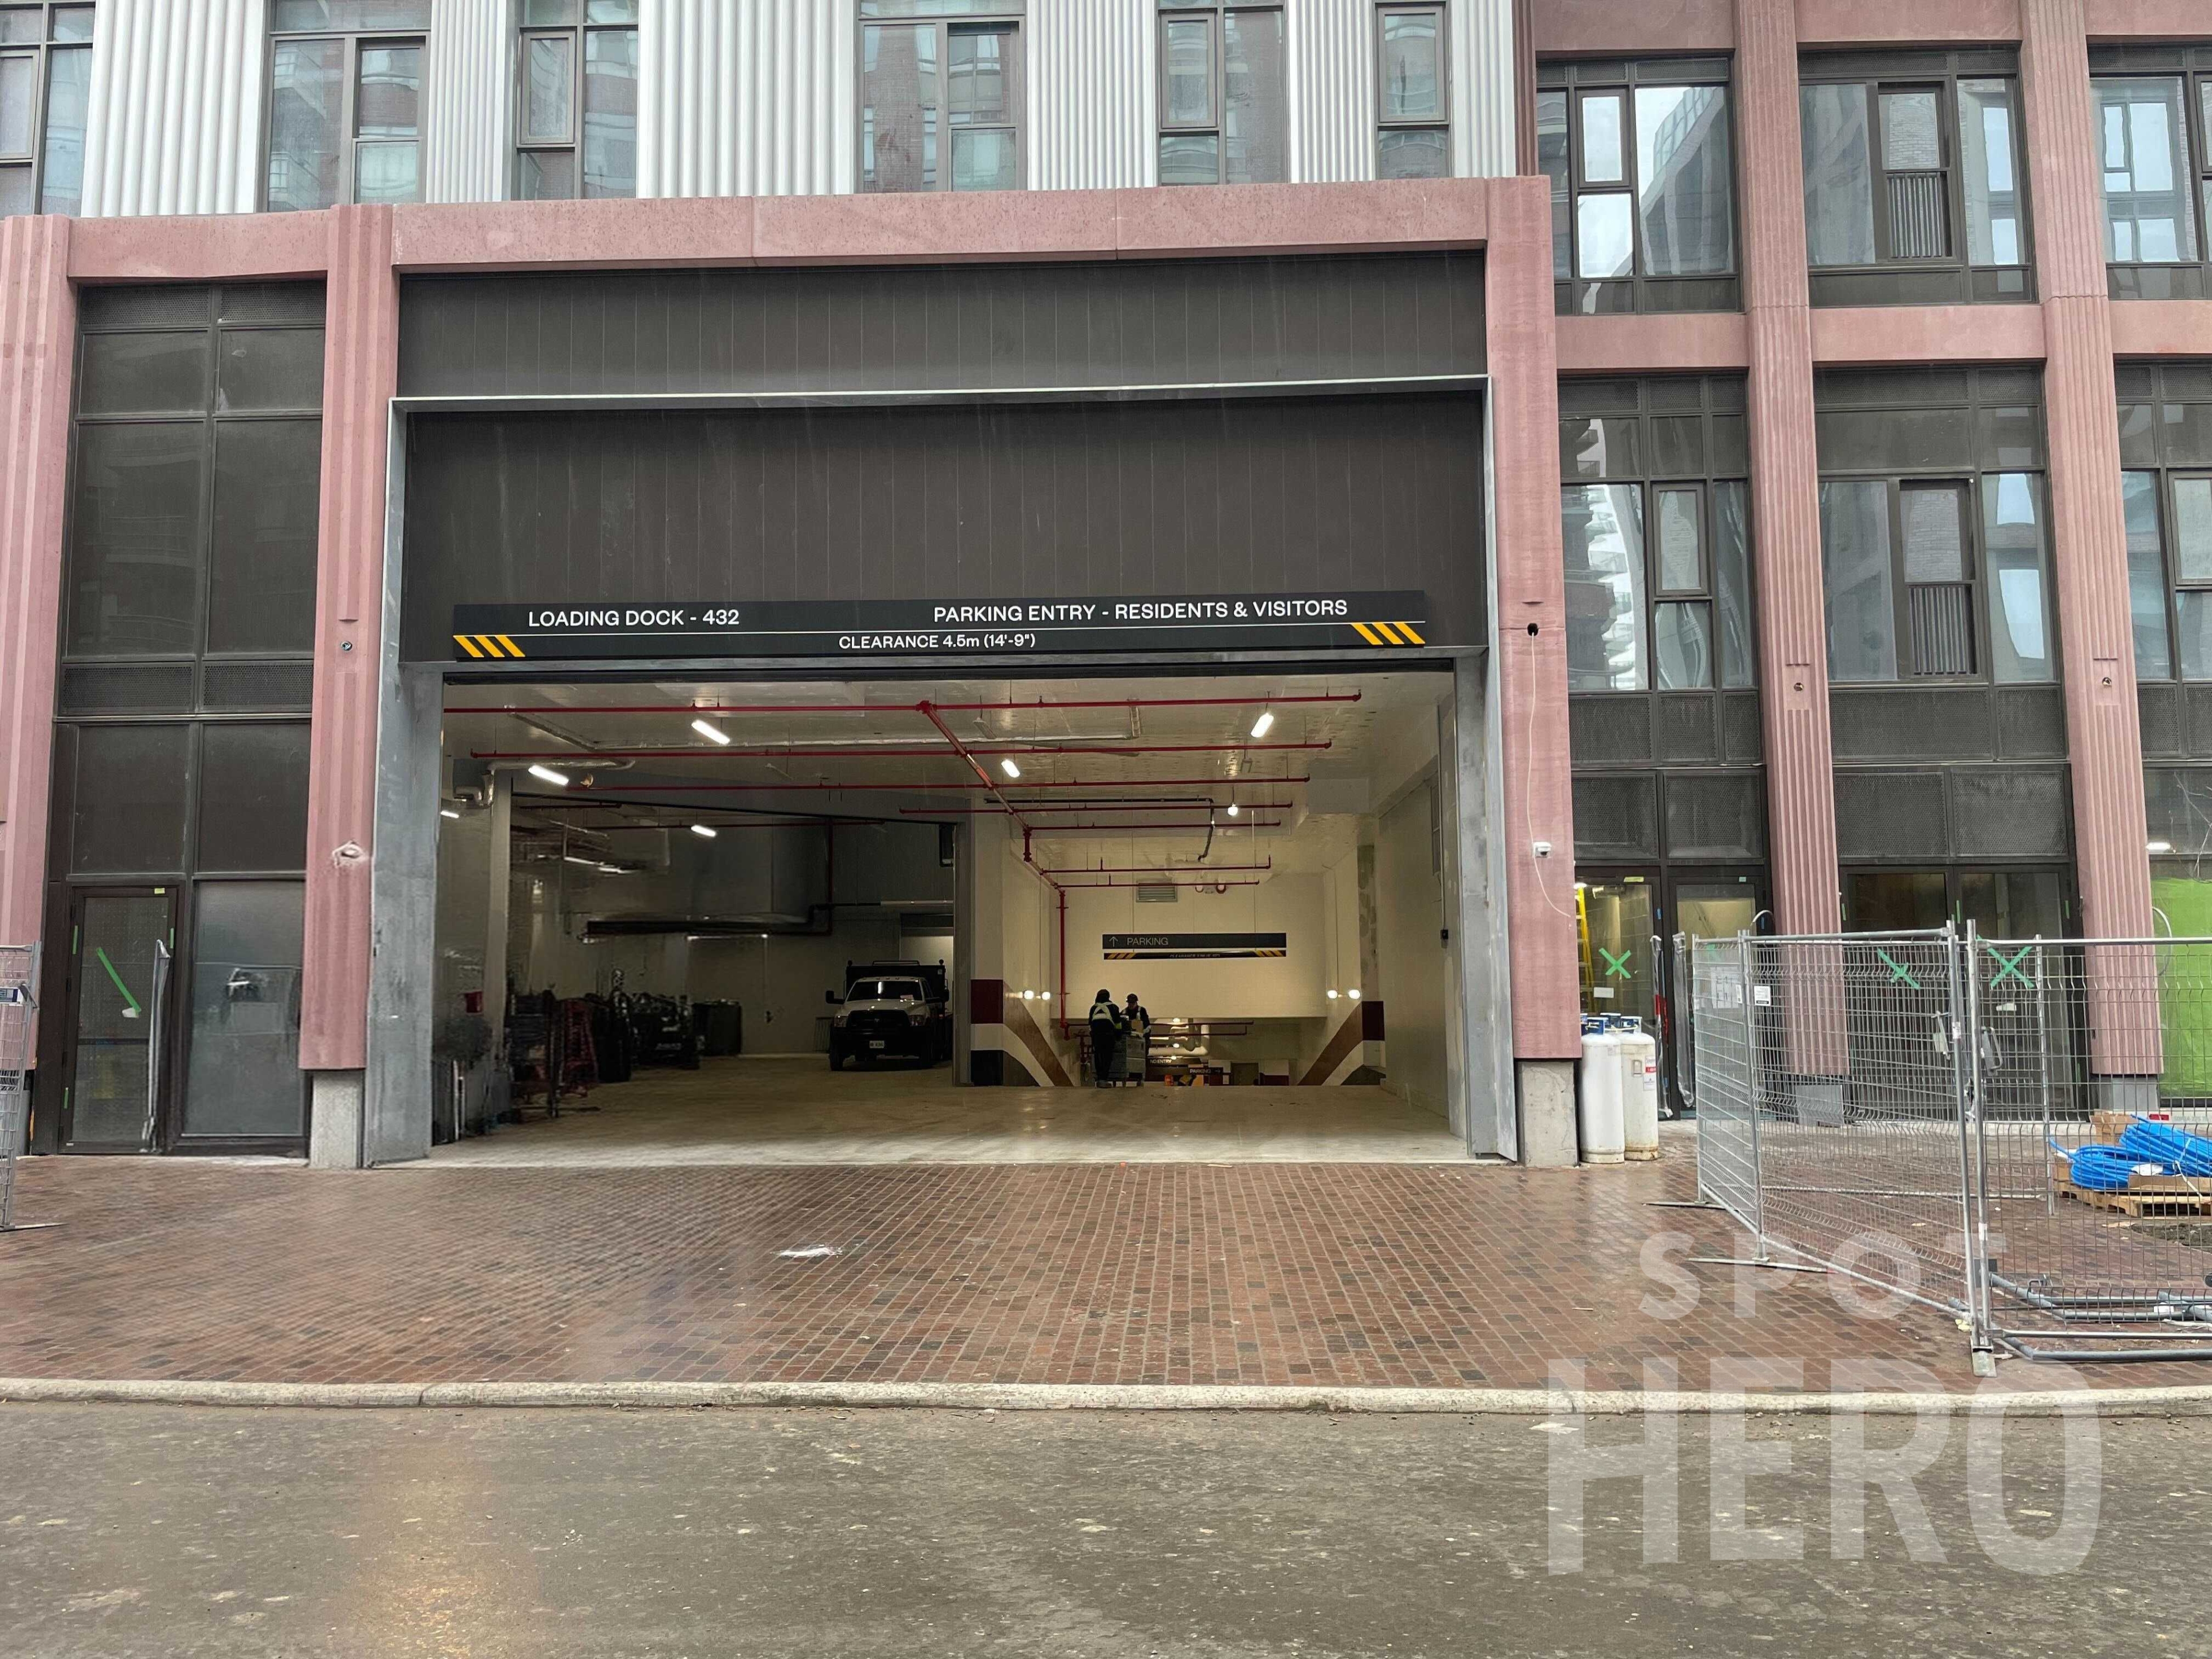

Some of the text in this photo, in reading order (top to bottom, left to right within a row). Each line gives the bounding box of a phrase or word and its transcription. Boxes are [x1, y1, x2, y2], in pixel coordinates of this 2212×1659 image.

[529, 610, 619, 627] LOADING
[626, 609, 684, 626] DOCK
[702, 609, 740, 625] 432
[934, 605, 1022, 623] PARKING
[1028, 604, 1096, 621] ENTRY
[1115, 601, 1228, 619] RESIDENTS
[1233, 601, 1248, 618] &
[1252, 600, 1347, 618] VISITORS
[839, 635, 939, 649] CLEARANCE
[942, 634, 979, 647] 4.5m
[1127, 937, 1169, 946] PARKING
